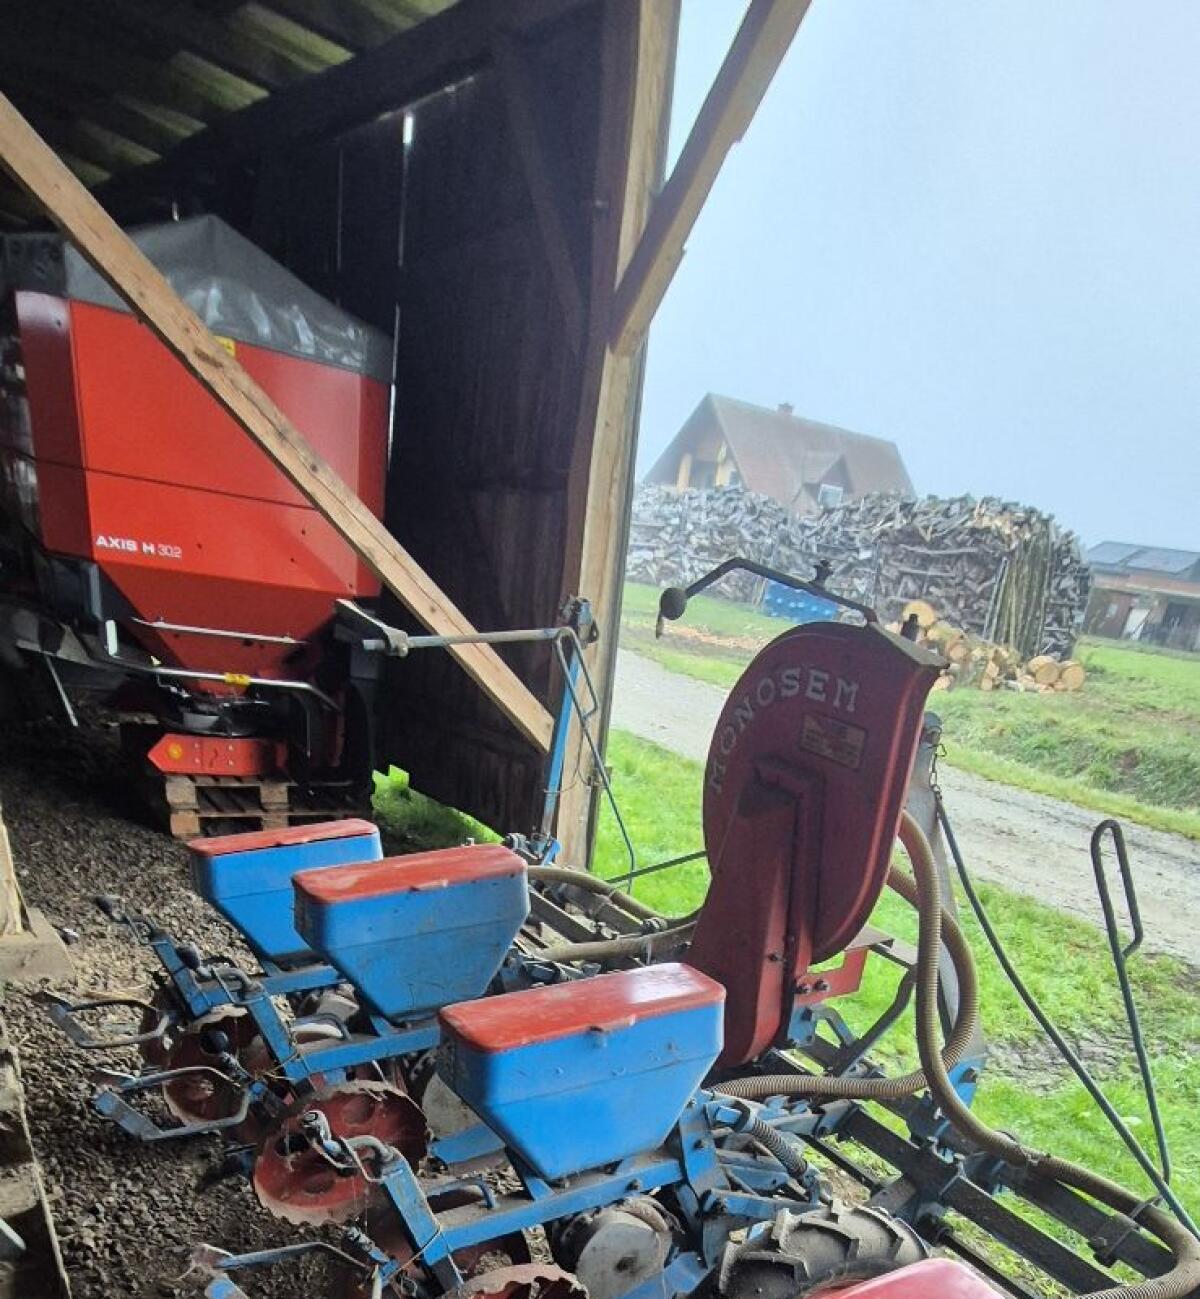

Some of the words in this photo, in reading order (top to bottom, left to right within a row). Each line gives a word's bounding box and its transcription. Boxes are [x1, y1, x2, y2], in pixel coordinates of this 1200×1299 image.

[96, 535, 138, 552] AXIS
[142, 542, 155, 555] H
[709, 667, 860, 795] MONOSEM
